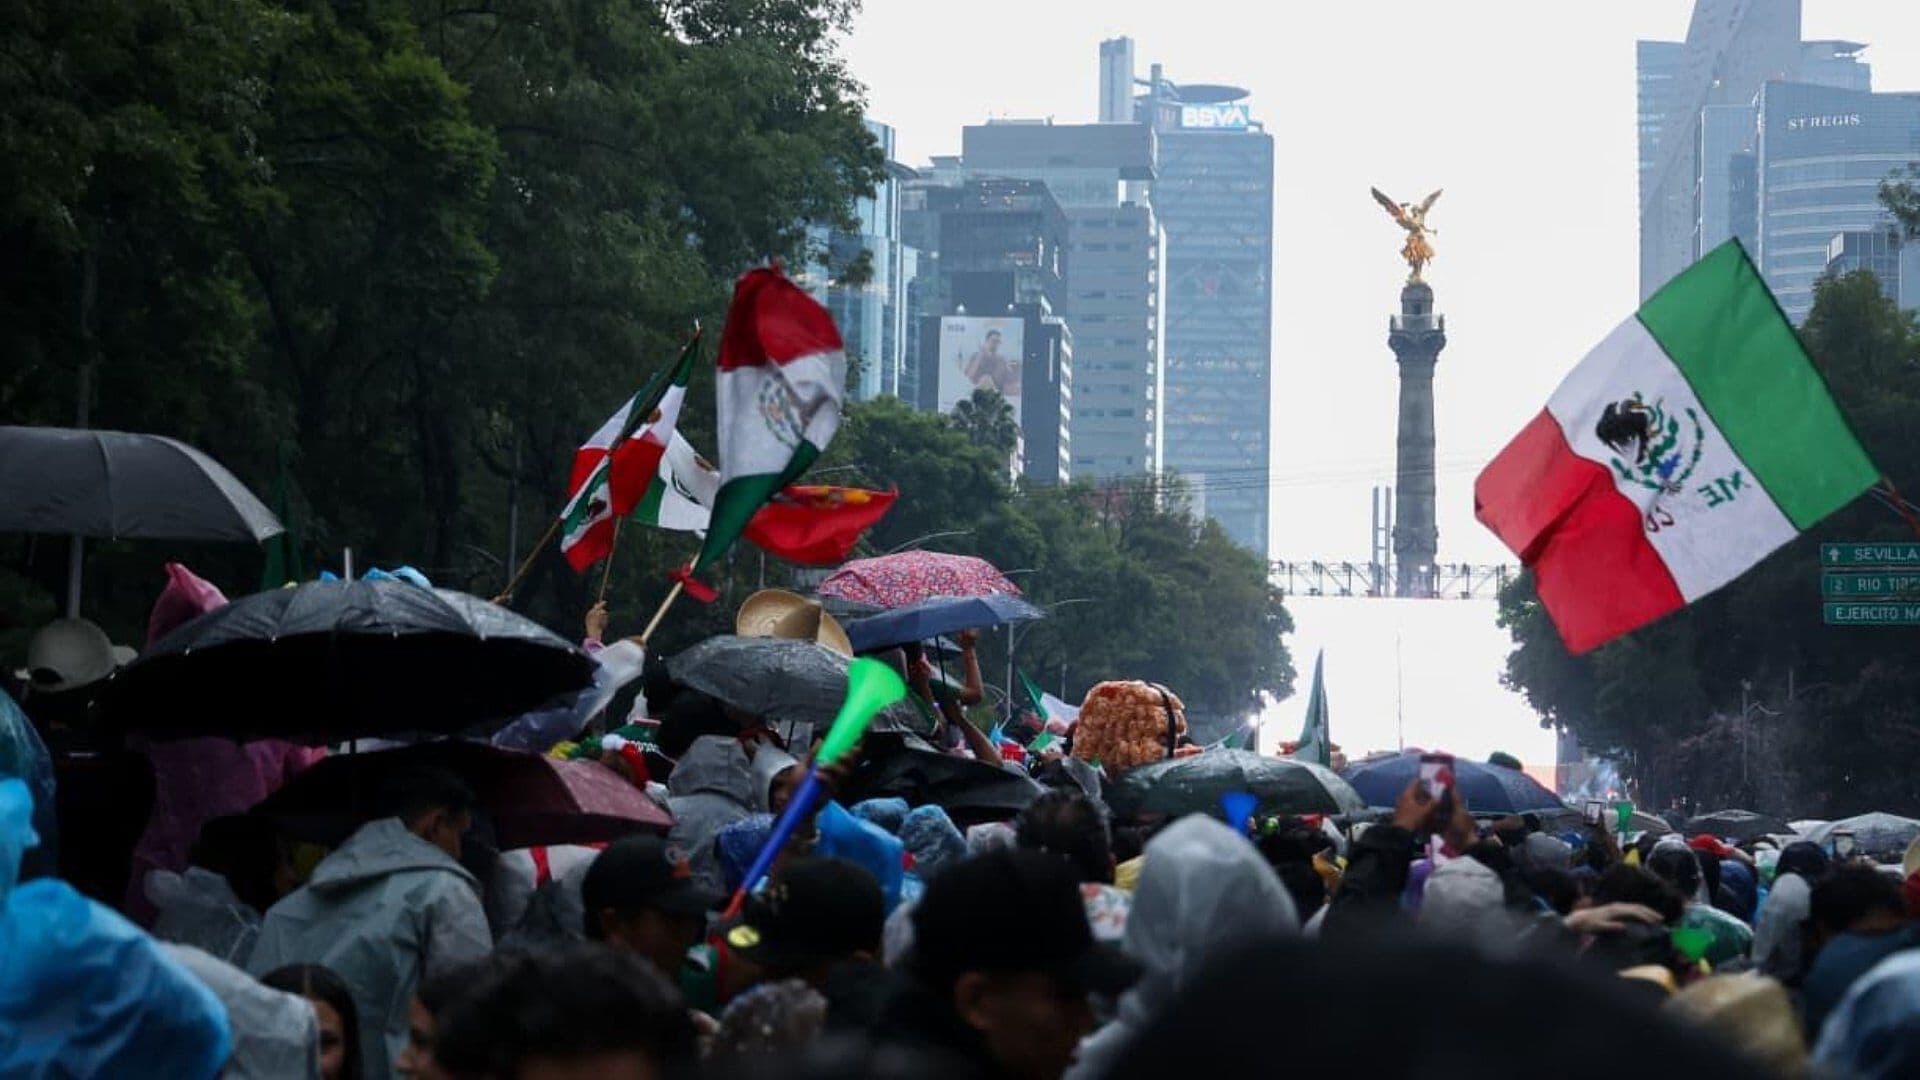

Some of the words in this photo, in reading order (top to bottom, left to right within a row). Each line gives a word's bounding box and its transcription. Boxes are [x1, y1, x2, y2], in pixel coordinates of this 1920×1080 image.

[1811, 113, 1860, 127] REGIS
[1855, 547, 1918, 561] SEVILLA
[1858, 578, 1881, 591] RIO
[1836, 606, 1898, 620] EJERCITO
